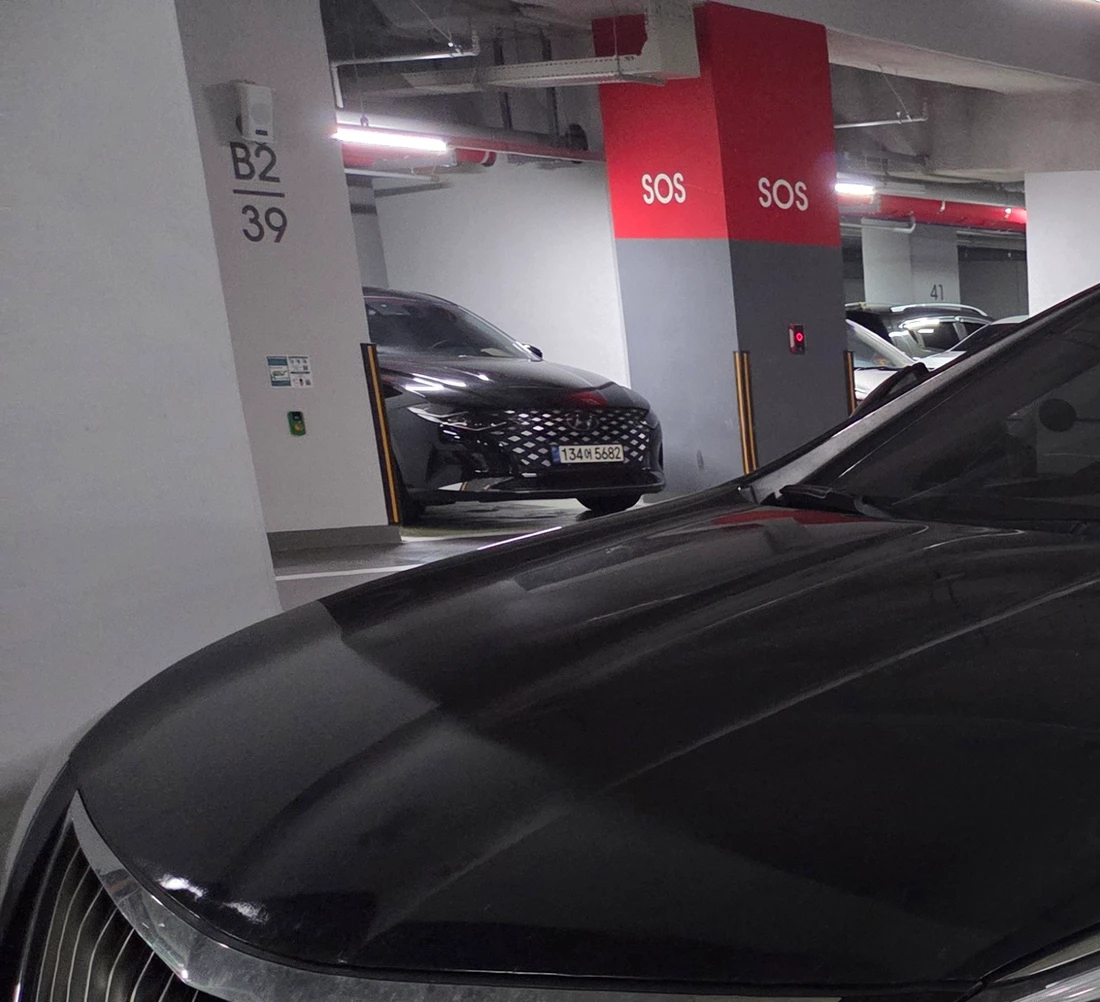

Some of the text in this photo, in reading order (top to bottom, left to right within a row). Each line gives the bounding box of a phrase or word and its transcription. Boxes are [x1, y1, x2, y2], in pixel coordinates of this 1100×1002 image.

[229, 142, 281, 183] B2
[641, 172, 687, 204] SOS
[758, 177, 809, 211] SOS
[241, 205, 287, 243] 39
[930, 284, 944, 300] 41
[562, 446, 621, 461] 134어 5682
